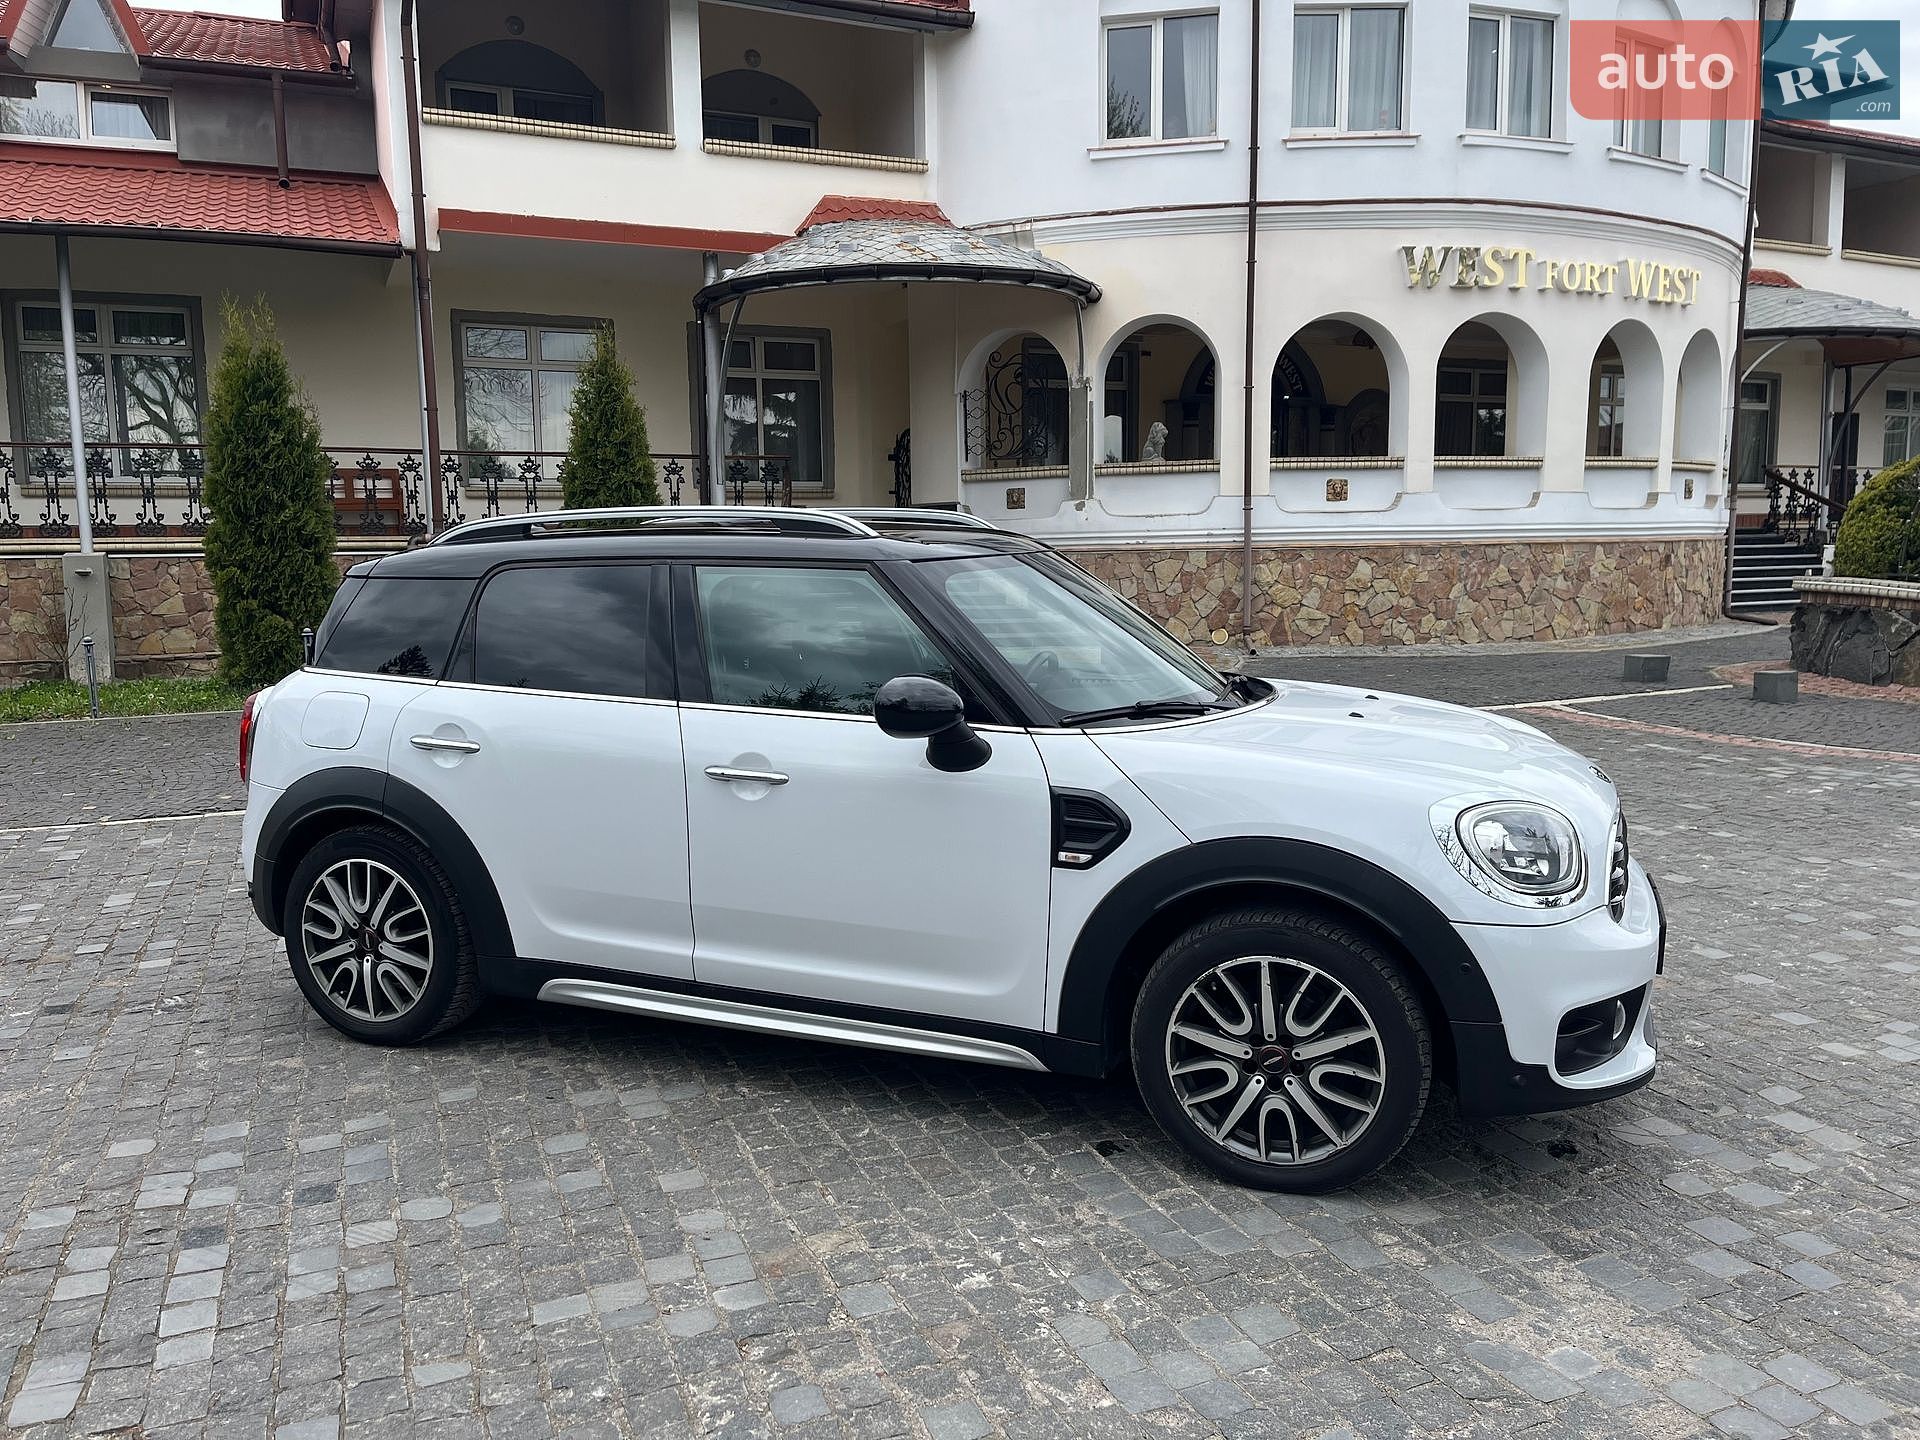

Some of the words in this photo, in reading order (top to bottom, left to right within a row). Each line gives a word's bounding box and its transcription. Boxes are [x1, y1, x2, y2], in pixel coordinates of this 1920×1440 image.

[1400, 245, 1536, 289] WEST
[1538, 259, 1619, 297] FORT
[1620, 257, 1702, 307] WEST
[1278, 353, 1304, 393] WEST
